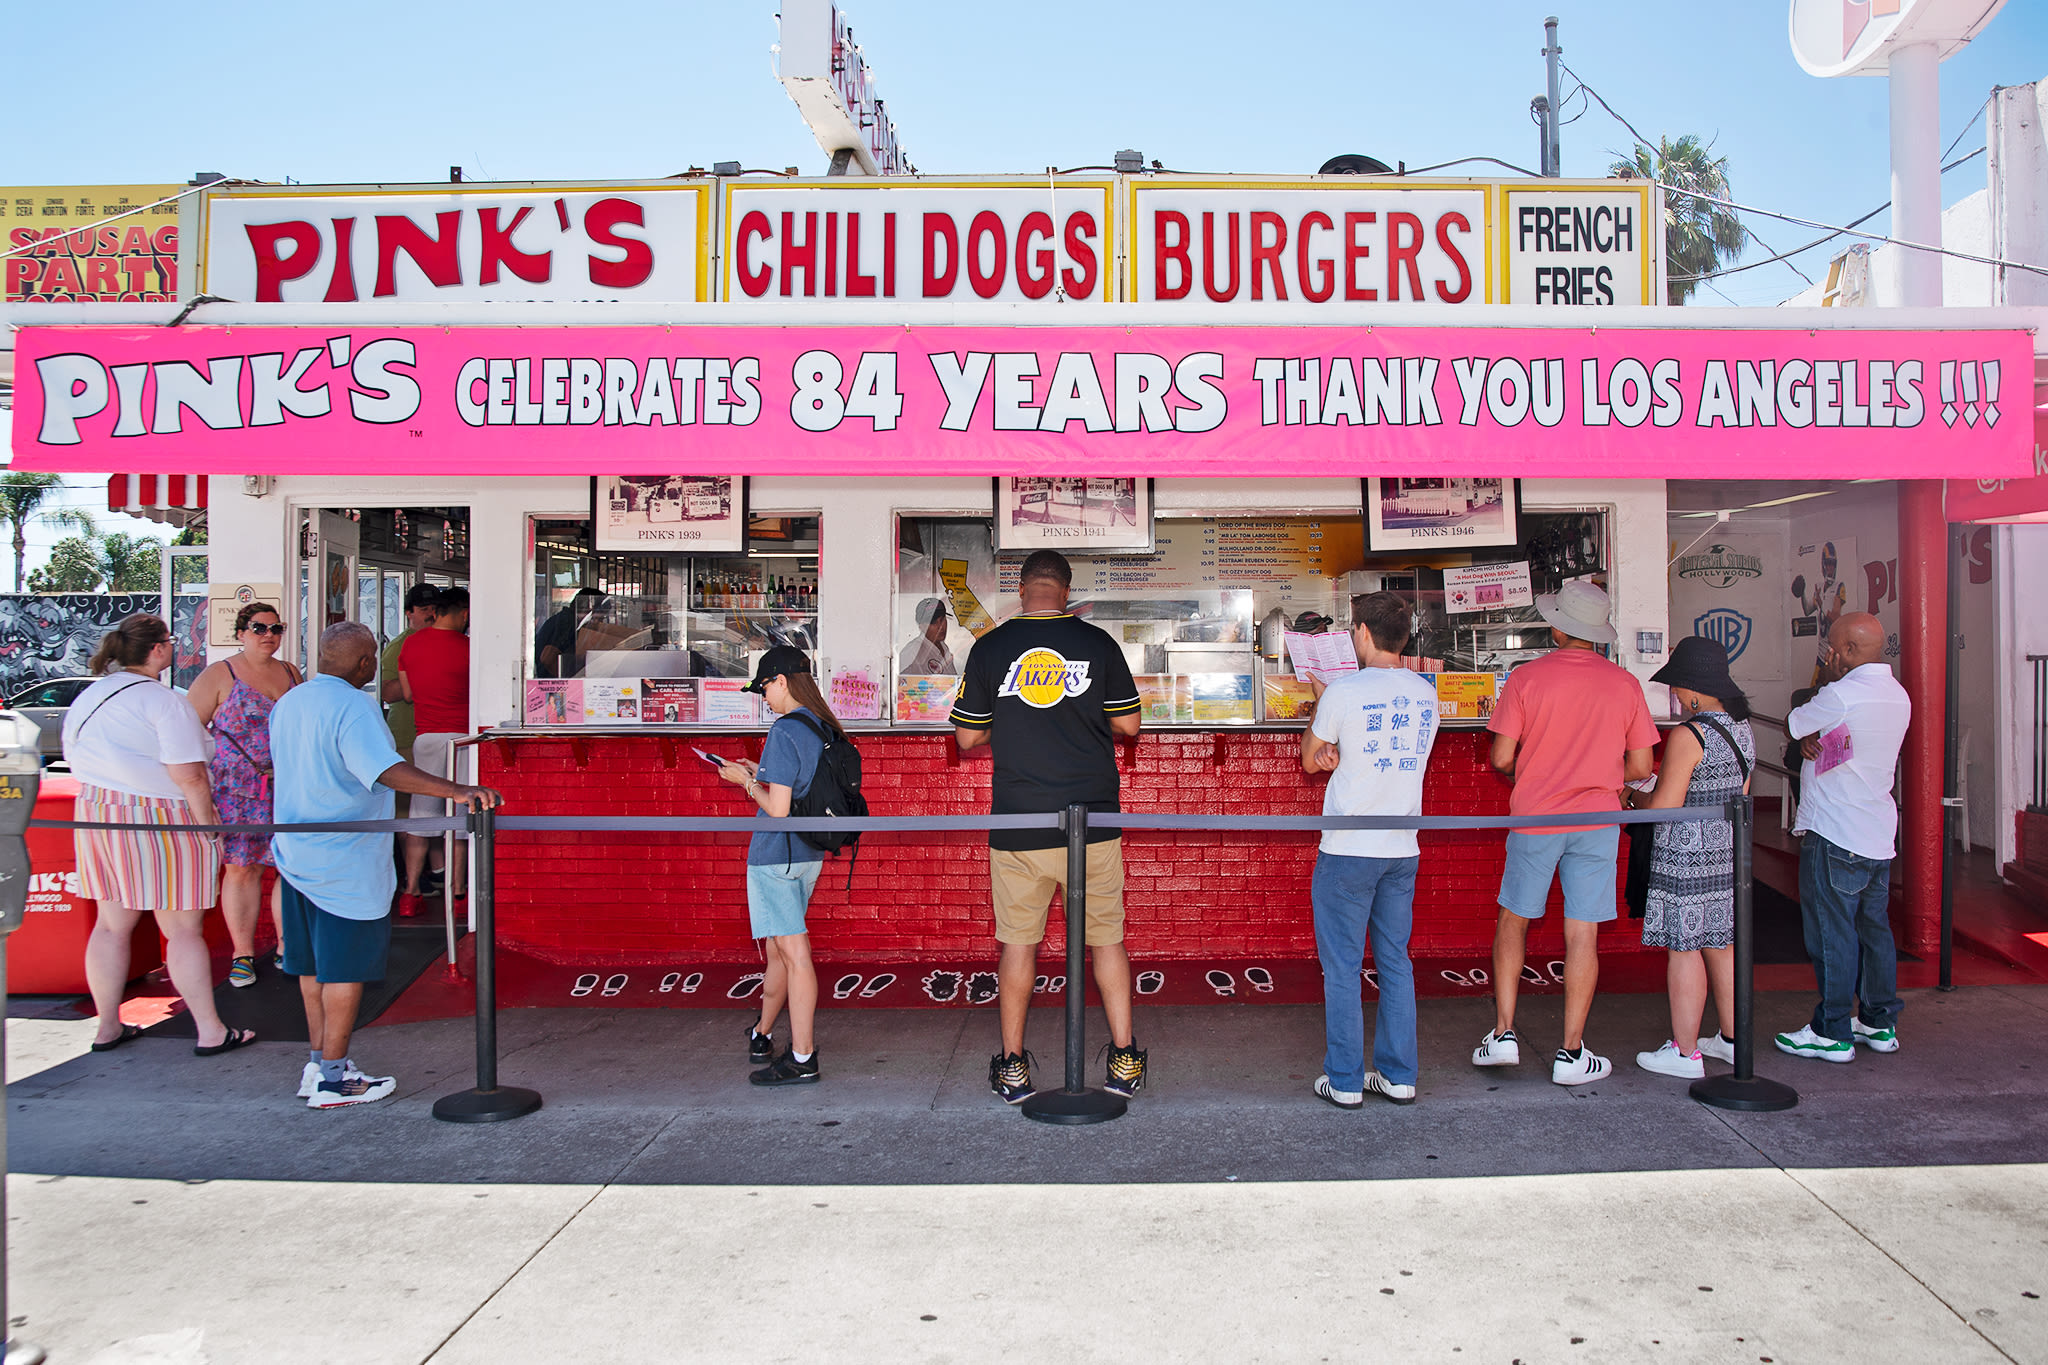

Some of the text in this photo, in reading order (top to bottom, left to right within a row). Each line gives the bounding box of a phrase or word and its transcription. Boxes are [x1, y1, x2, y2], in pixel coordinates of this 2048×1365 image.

[16, 206, 33, 216] CERA
[75, 206, 95, 216] FORTE
[1519, 206, 1633, 252] FRENCH
[244, 197, 654, 302] PINK'S
[736, 210, 1098, 299] CHILI DOGS
[1154, 210, 1473, 302] BURGERS
[1536, 266, 1614, 305] FRIES
[34, 335, 2002, 446] PINK'S CELEBRATES 84 YEARS THANK YOU LOS ANGELES !!!
[638, 530, 702, 540] PINK'S 1939
[1042, 527, 1106, 537] PINK'S 1941
[1411, 526, 1475, 538] PINK'S 1946
[1690, 570, 1752, 578] HOLLYWOOD
[1508, 586, 1528, 595] $8.50
[1008, 664, 1084, 693] LAKERS
[30, 904, 53, 912] SINCE
